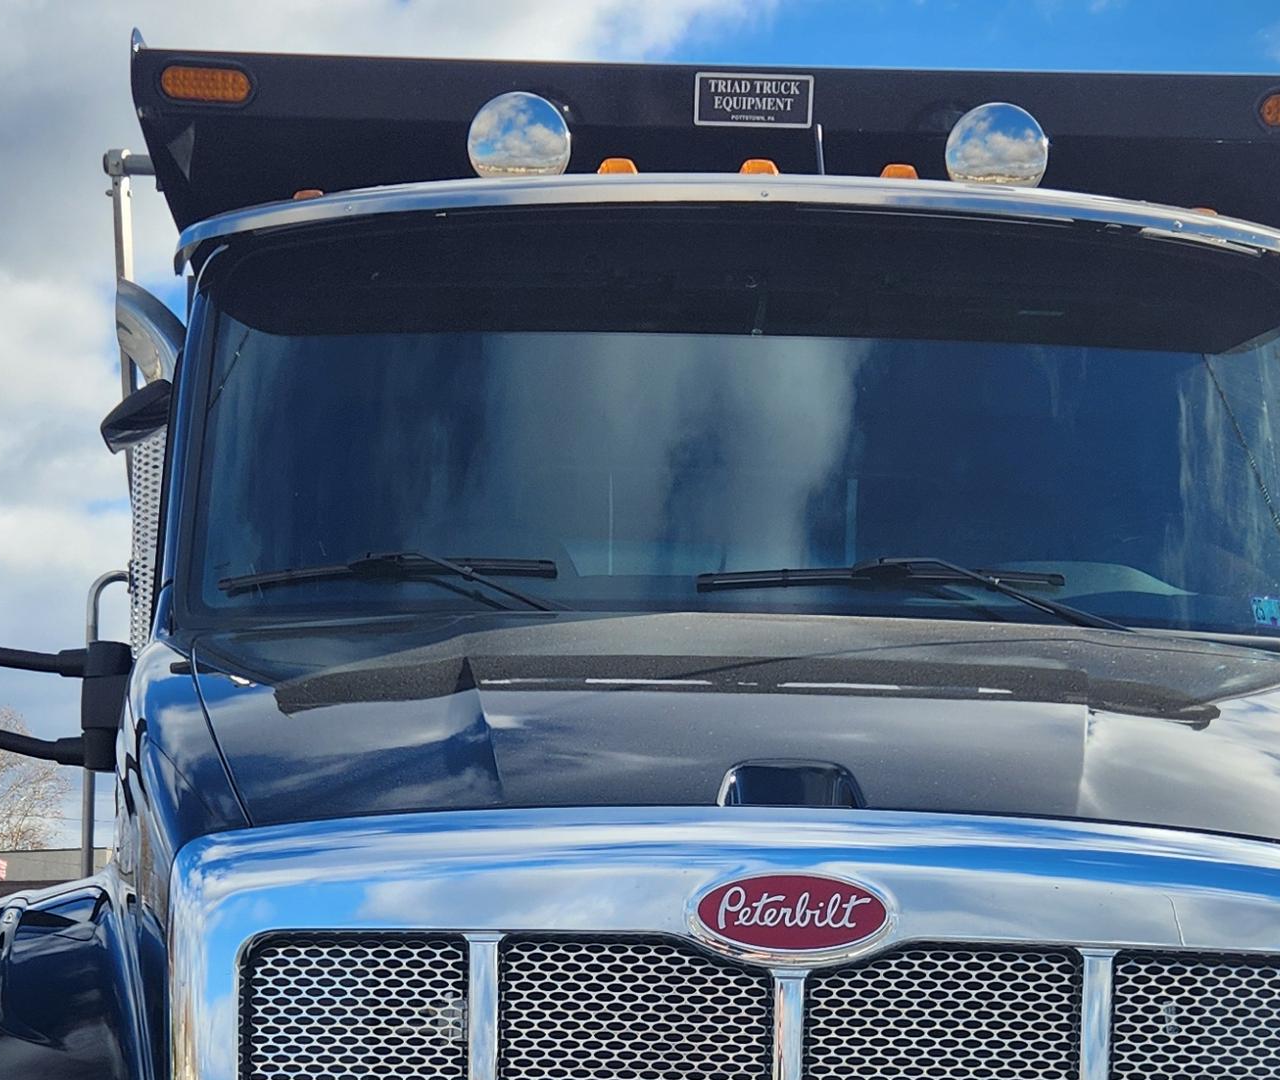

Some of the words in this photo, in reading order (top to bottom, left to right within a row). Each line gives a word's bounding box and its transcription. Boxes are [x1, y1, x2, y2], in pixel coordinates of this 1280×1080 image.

[708, 79, 750, 94] TRIAD
[753, 80, 800, 95] TRUCK
[713, 96, 794, 112] EQUIPMENT
[717, 886, 872, 930] Peterbilt
